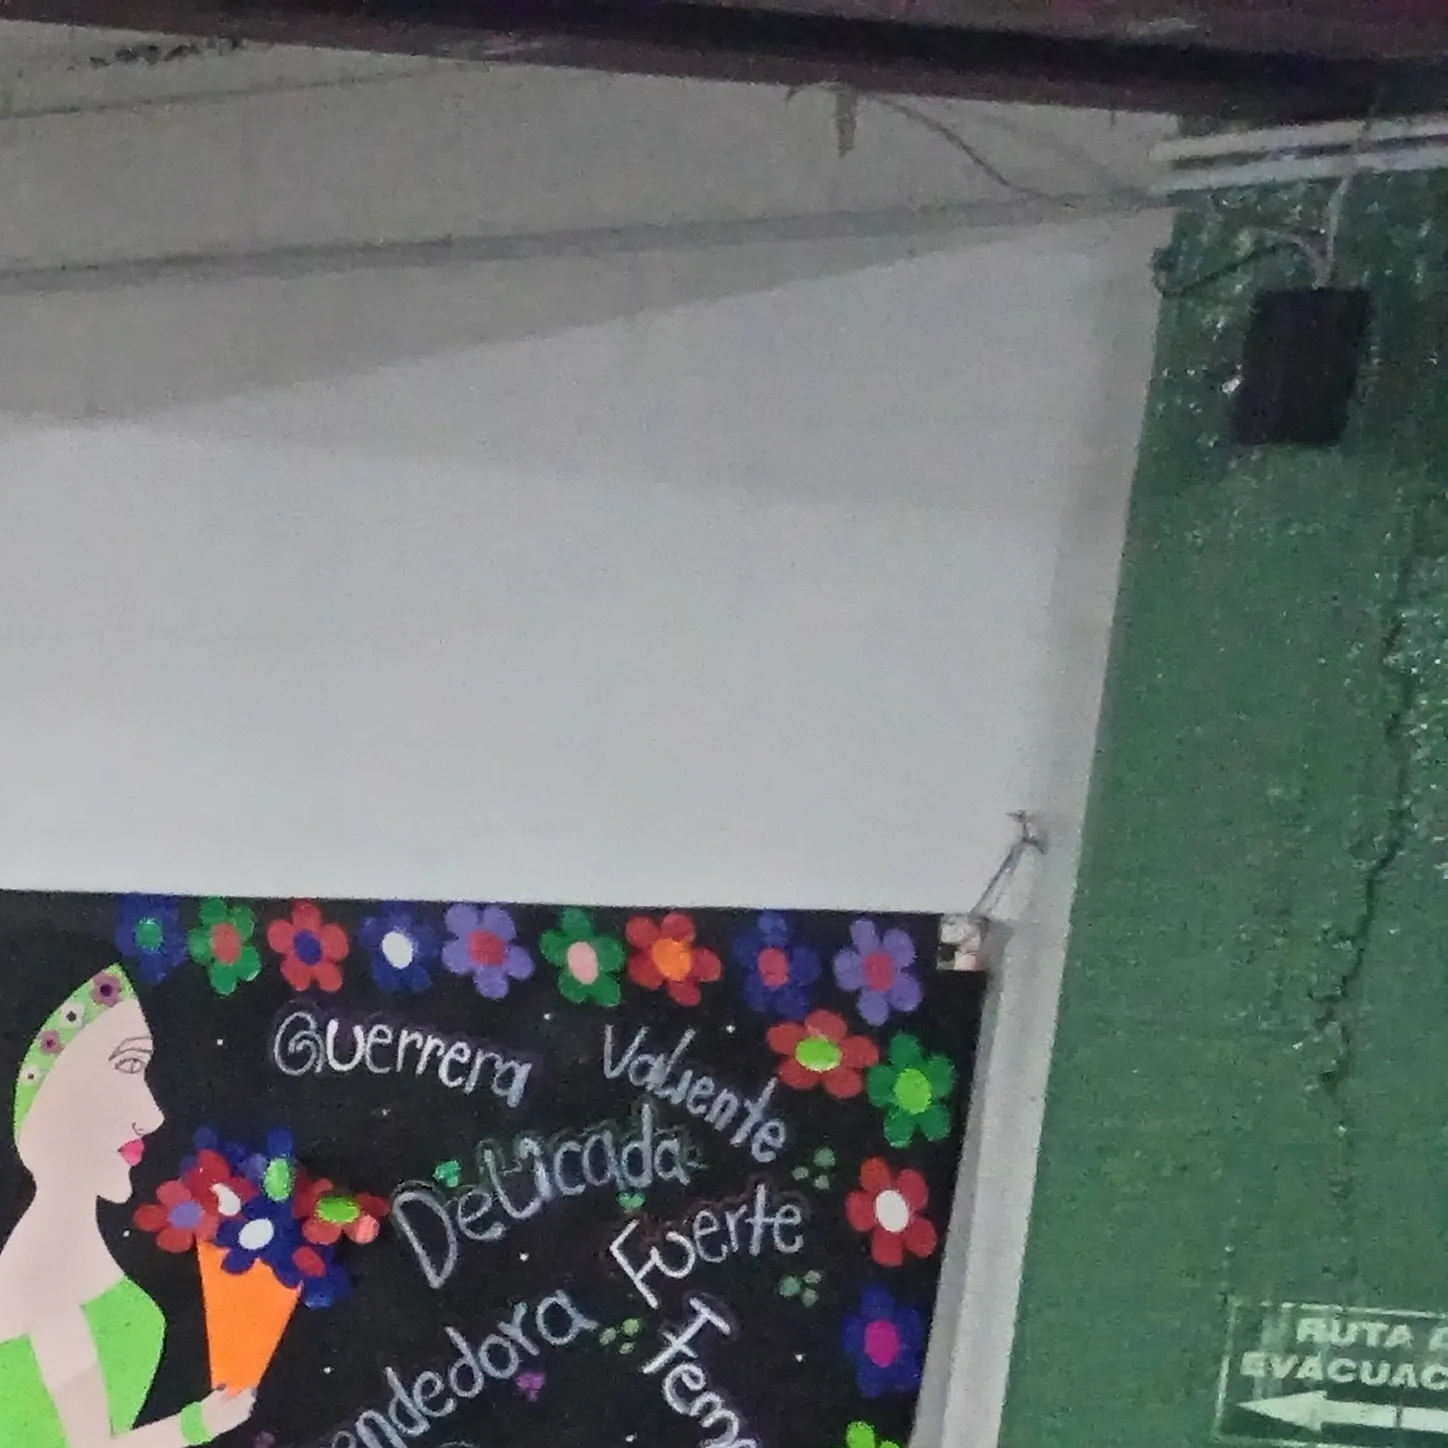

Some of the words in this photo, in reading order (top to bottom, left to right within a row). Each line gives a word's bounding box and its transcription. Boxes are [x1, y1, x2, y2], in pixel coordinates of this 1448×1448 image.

[272, 1009, 532, 1108] Guerrera
[604, 1022, 787, 1164] Valiente
[392, 1102, 692, 1290] Delicada
[608, 1183, 805, 1310] Fuerte
[1296, 1316, 1414, 1350] RUTA
